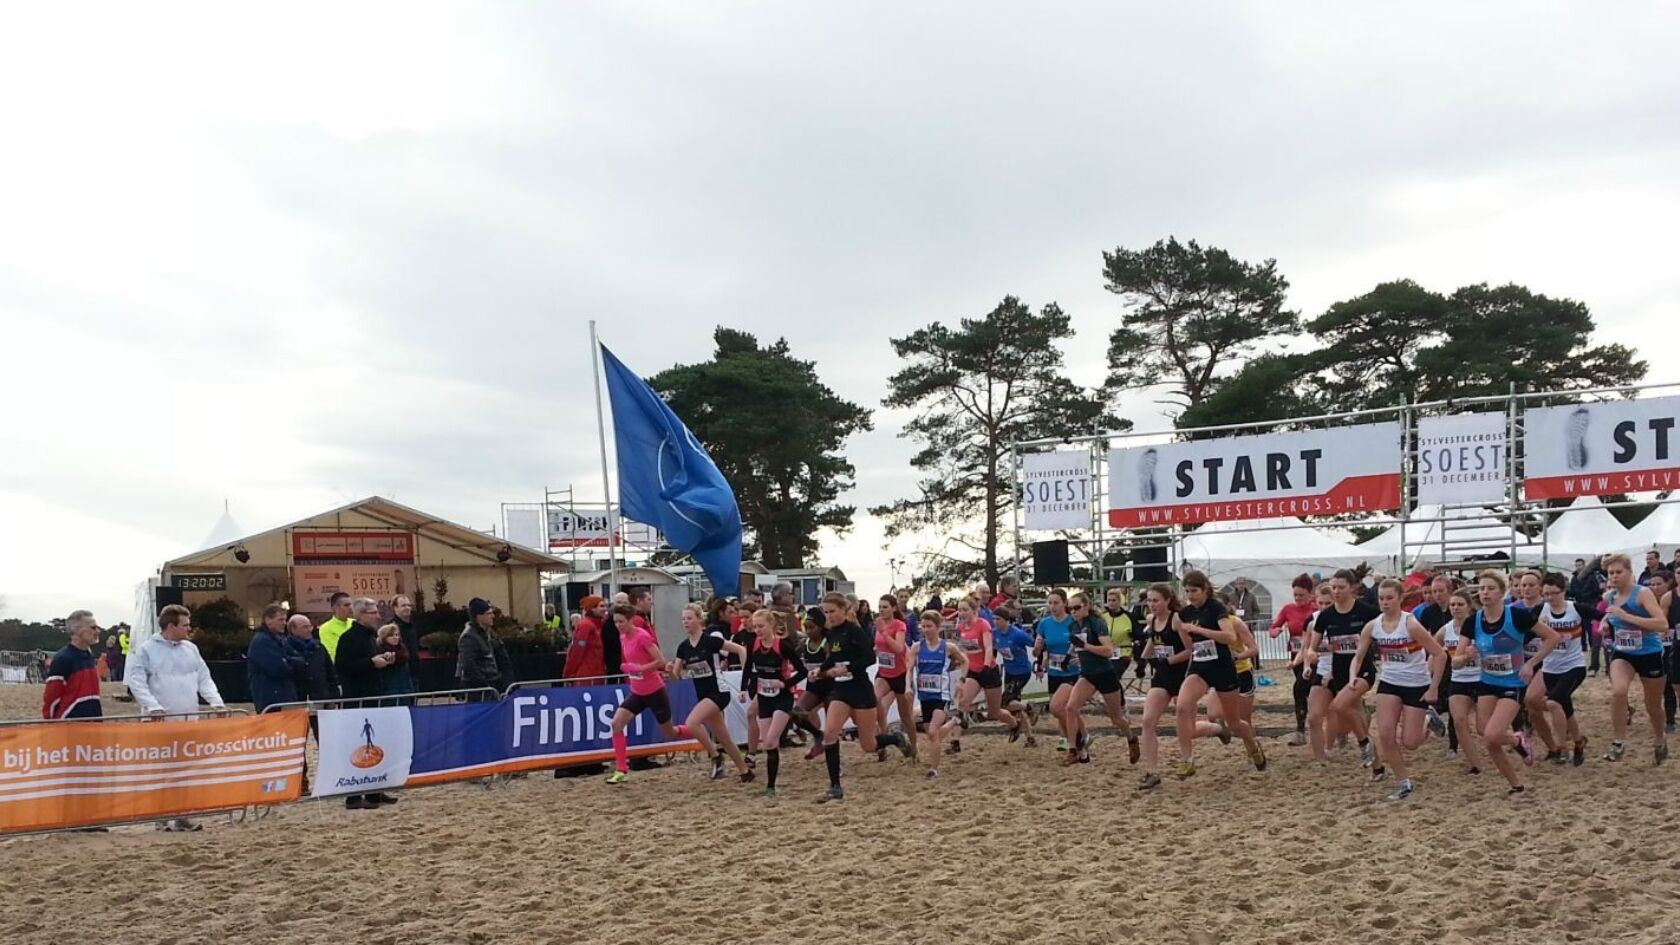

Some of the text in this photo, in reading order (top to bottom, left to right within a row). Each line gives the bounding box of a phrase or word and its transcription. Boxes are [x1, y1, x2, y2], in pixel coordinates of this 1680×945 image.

[1421, 433, 1502, 446] SYLVESTERCROSS
[1421, 445, 1502, 474] SOEST
[1026, 468, 1088, 479] SYLVESTERCROSS
[1176, 449, 1323, 498] START
[1422, 471, 1499, 485] 31 DECEMBER
[1563, 472, 1680, 493] WWW.SYLV
[1026, 478, 1088, 504] SOEST
[1042, 502, 1087, 513] DECEMBER
[1138, 495, 1366, 523] WWW.SYLVESTERCROSS.NL
[352, 578, 390, 590] SOEST
[4, 731, 288, 774] bij het Nationaal Crosscircuit
[336, 772, 389, 788] Rabobank
